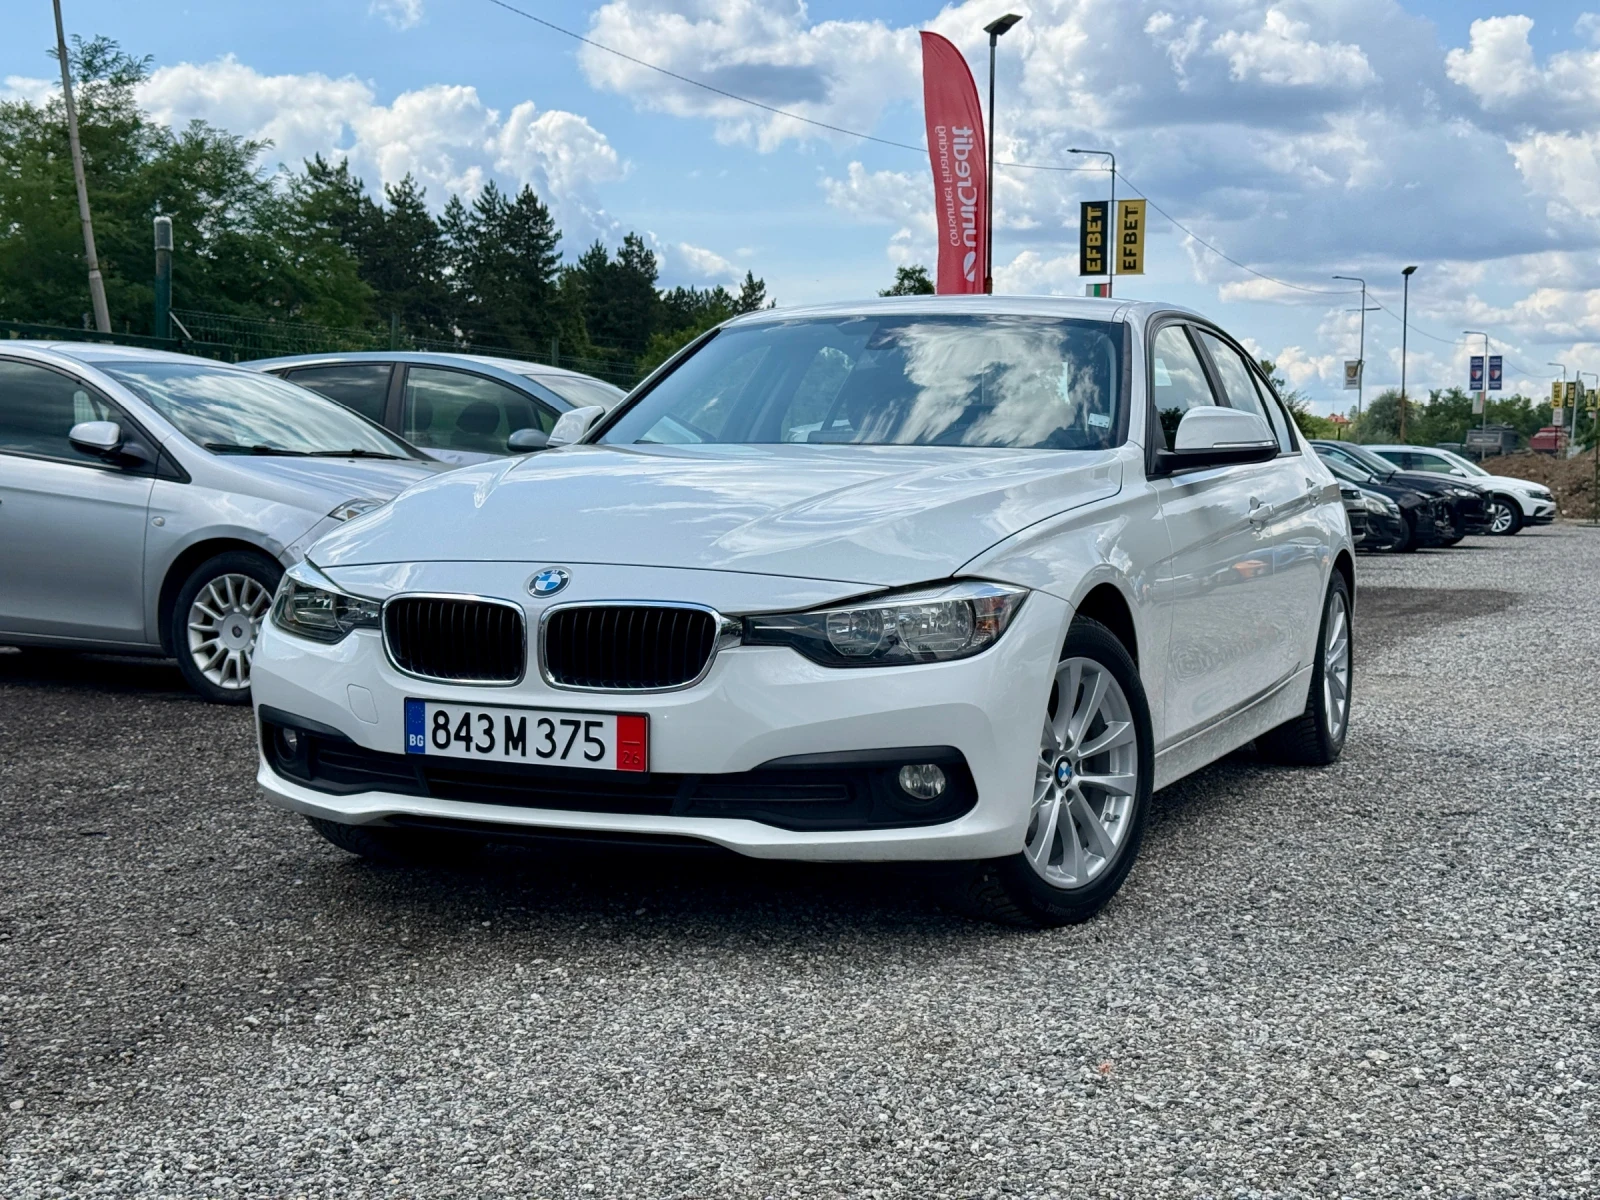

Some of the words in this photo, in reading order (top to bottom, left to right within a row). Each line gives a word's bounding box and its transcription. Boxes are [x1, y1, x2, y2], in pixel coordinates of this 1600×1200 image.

[1086, 206, 1102, 272] EFBET
[1123, 205, 1138, 270] EFBET
[409, 734, 424, 747] BG
[432, 710, 495, 753] 843
[505, 715, 527, 757] M
[536, 717, 606, 762] 375
[622, 751, 640, 765] 26
